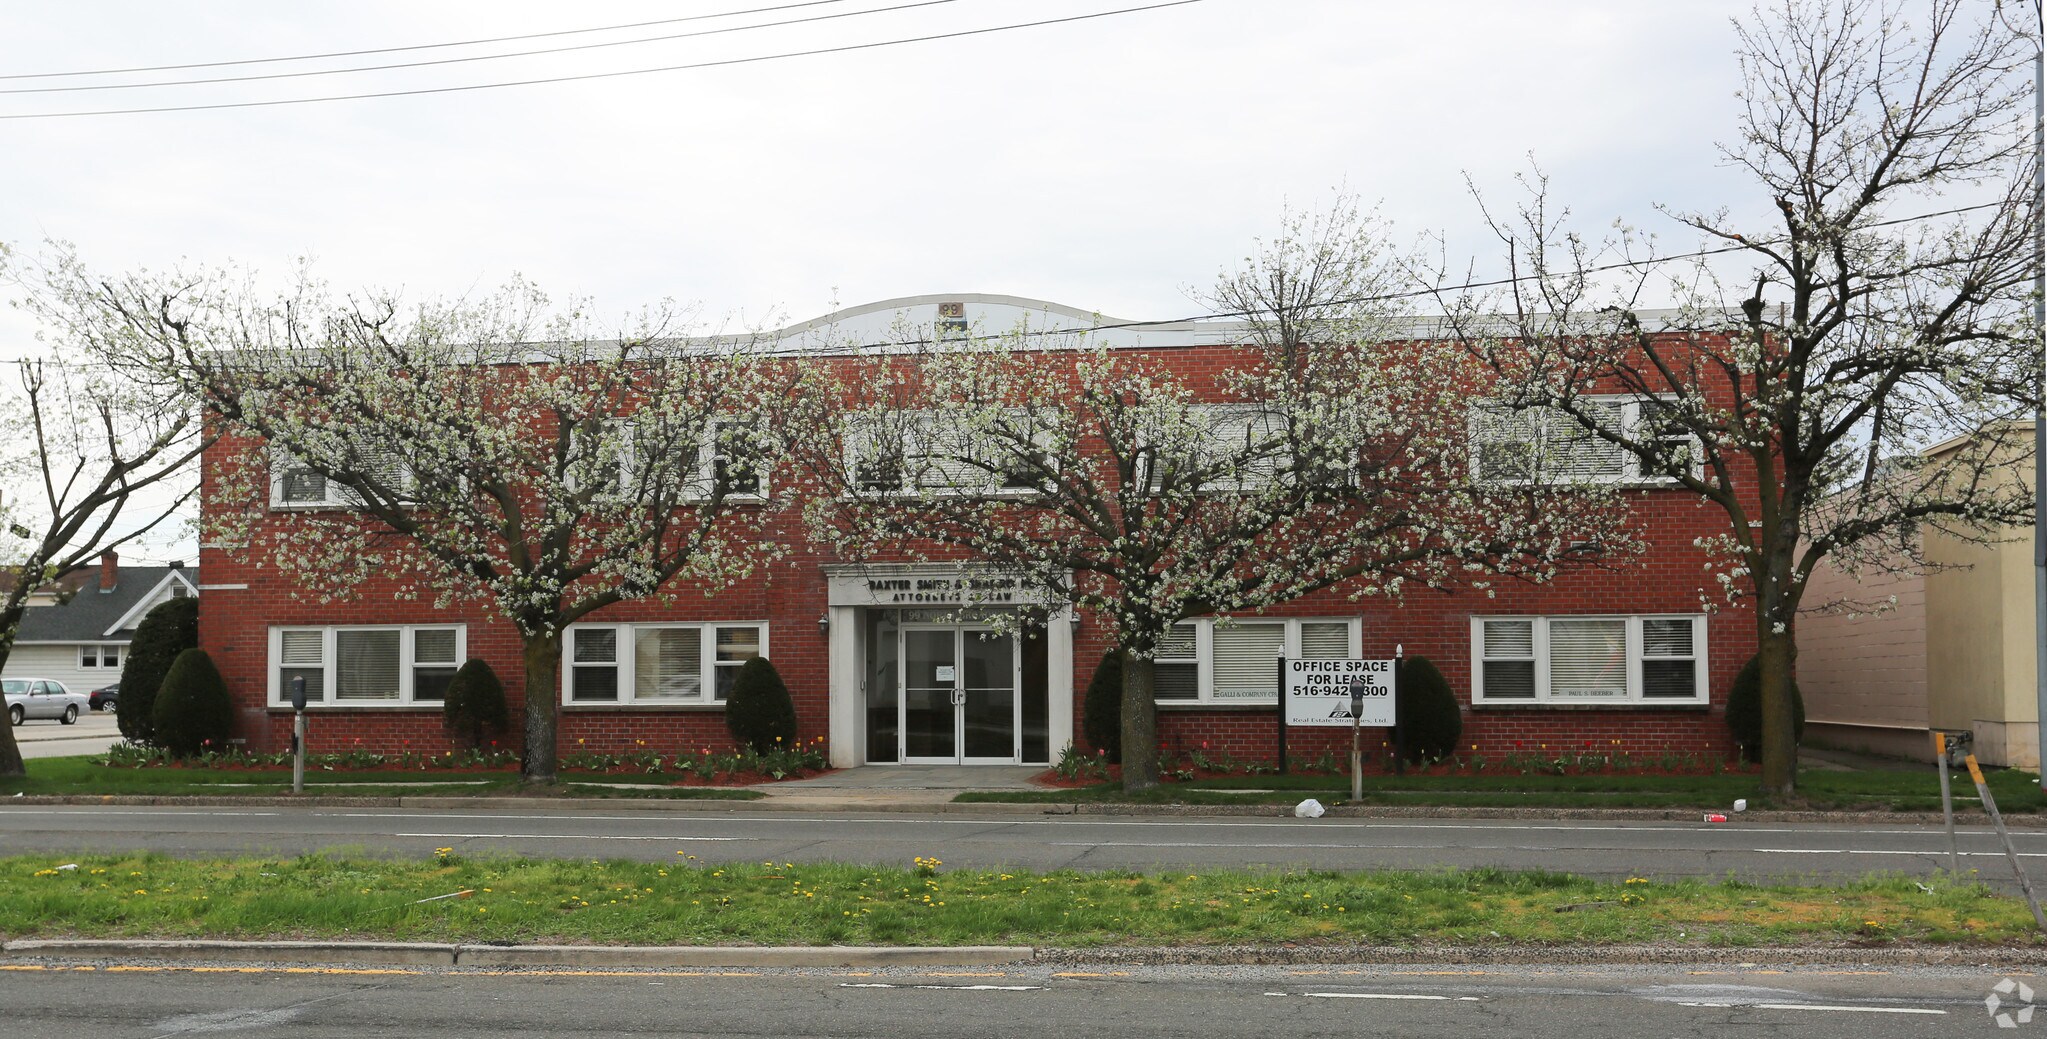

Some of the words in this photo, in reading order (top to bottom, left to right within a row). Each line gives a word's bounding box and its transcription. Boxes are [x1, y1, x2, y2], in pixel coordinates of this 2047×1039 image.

[869, 579, 911, 590] BAXTER
[917, 579, 950, 590] SMITH
[989, 592, 1012, 601] LAW
[909, 610, 921, 621] 99
[1293, 661, 1341, 672] OFFICE
[1345, 661, 1388, 672] SPACE
[1306, 674, 1332, 685] FOR
[1335, 674, 1374, 685] LEASE
